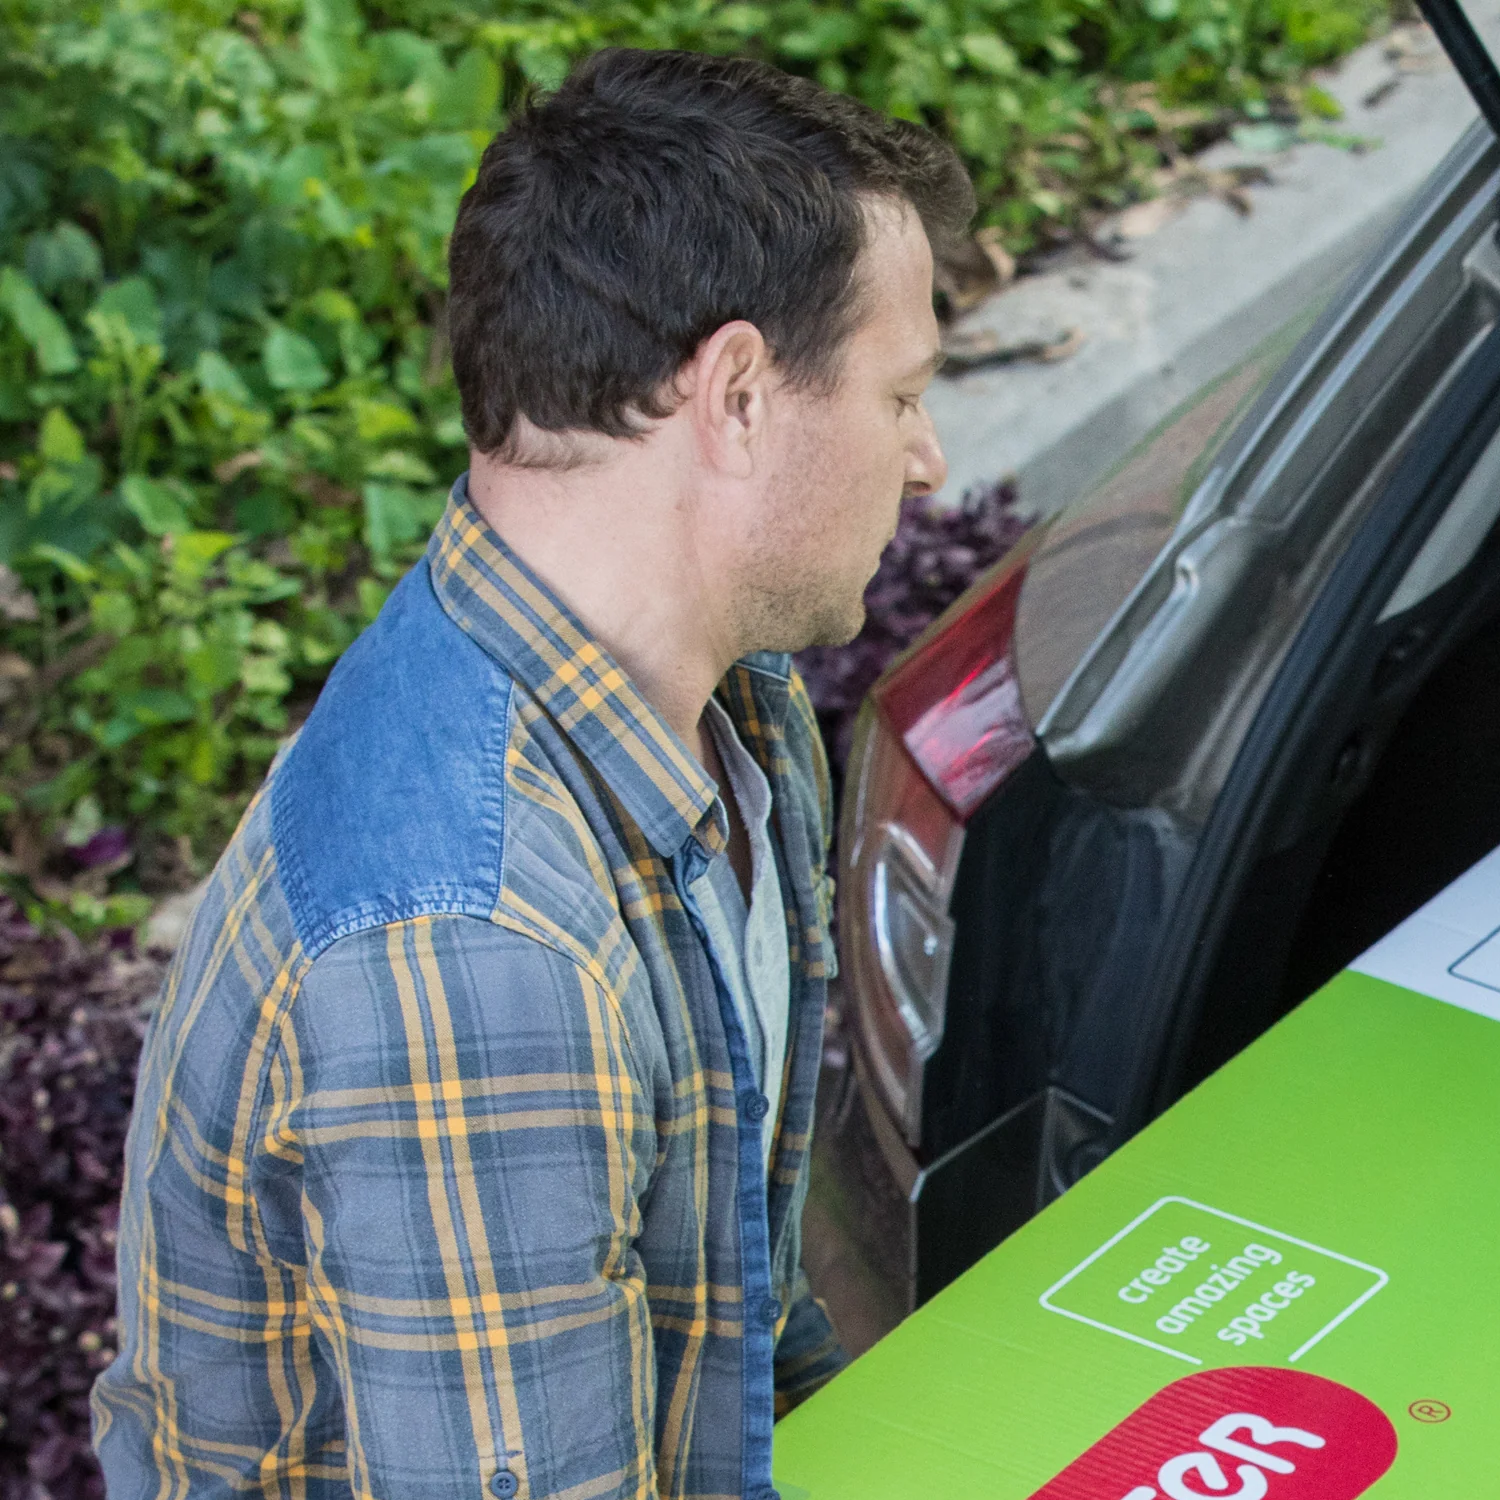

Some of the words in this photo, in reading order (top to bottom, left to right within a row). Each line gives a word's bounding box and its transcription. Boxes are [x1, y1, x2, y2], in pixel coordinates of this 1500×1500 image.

[1117, 1233, 1211, 1304] create
[1155, 1241, 1284, 1335] amazing
[1217, 1269, 1316, 1346] spaces
